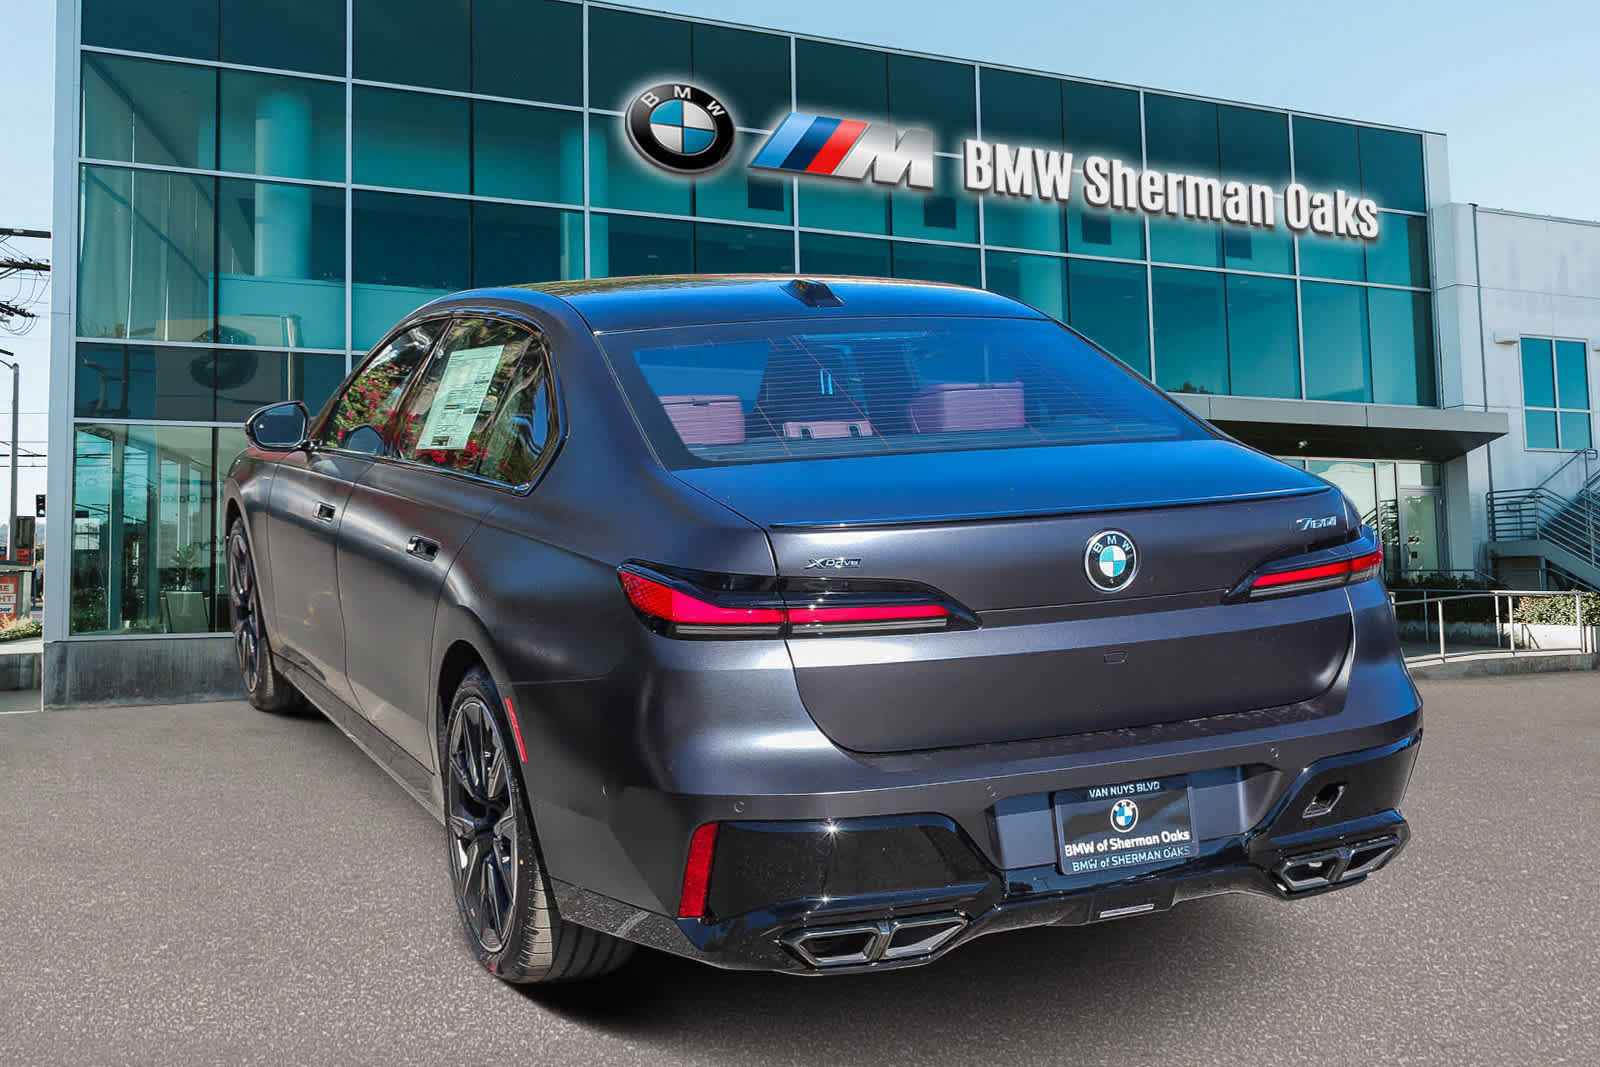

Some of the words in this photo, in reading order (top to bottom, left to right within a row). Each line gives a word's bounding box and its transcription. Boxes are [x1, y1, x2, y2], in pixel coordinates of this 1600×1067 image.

[641, 85, 725, 117] BMW
[963, 138, 1074, 201] BMW
[1083, 155, 1278, 227] Sherman
[1283, 182, 1380, 241] Oaks
[1092, 535, 1131, 553] BMW
[1089, 788, 1108, 799] VAN
[1110, 784, 1135, 795] NUYS
[1136, 781, 1160, 792] BLVD
[1064, 841, 1095, 857] BMW
[1096, 839, 1108, 851] of
[1109, 834, 1160, 850] Sherman
[1161, 829, 1191, 843] Oaks
[1072, 858, 1098, 872] BMW
[1100, 857, 1110, 868] of
[1111, 850, 1162, 866] SHERMAN
[1163, 846, 1191, 859] OAKS
